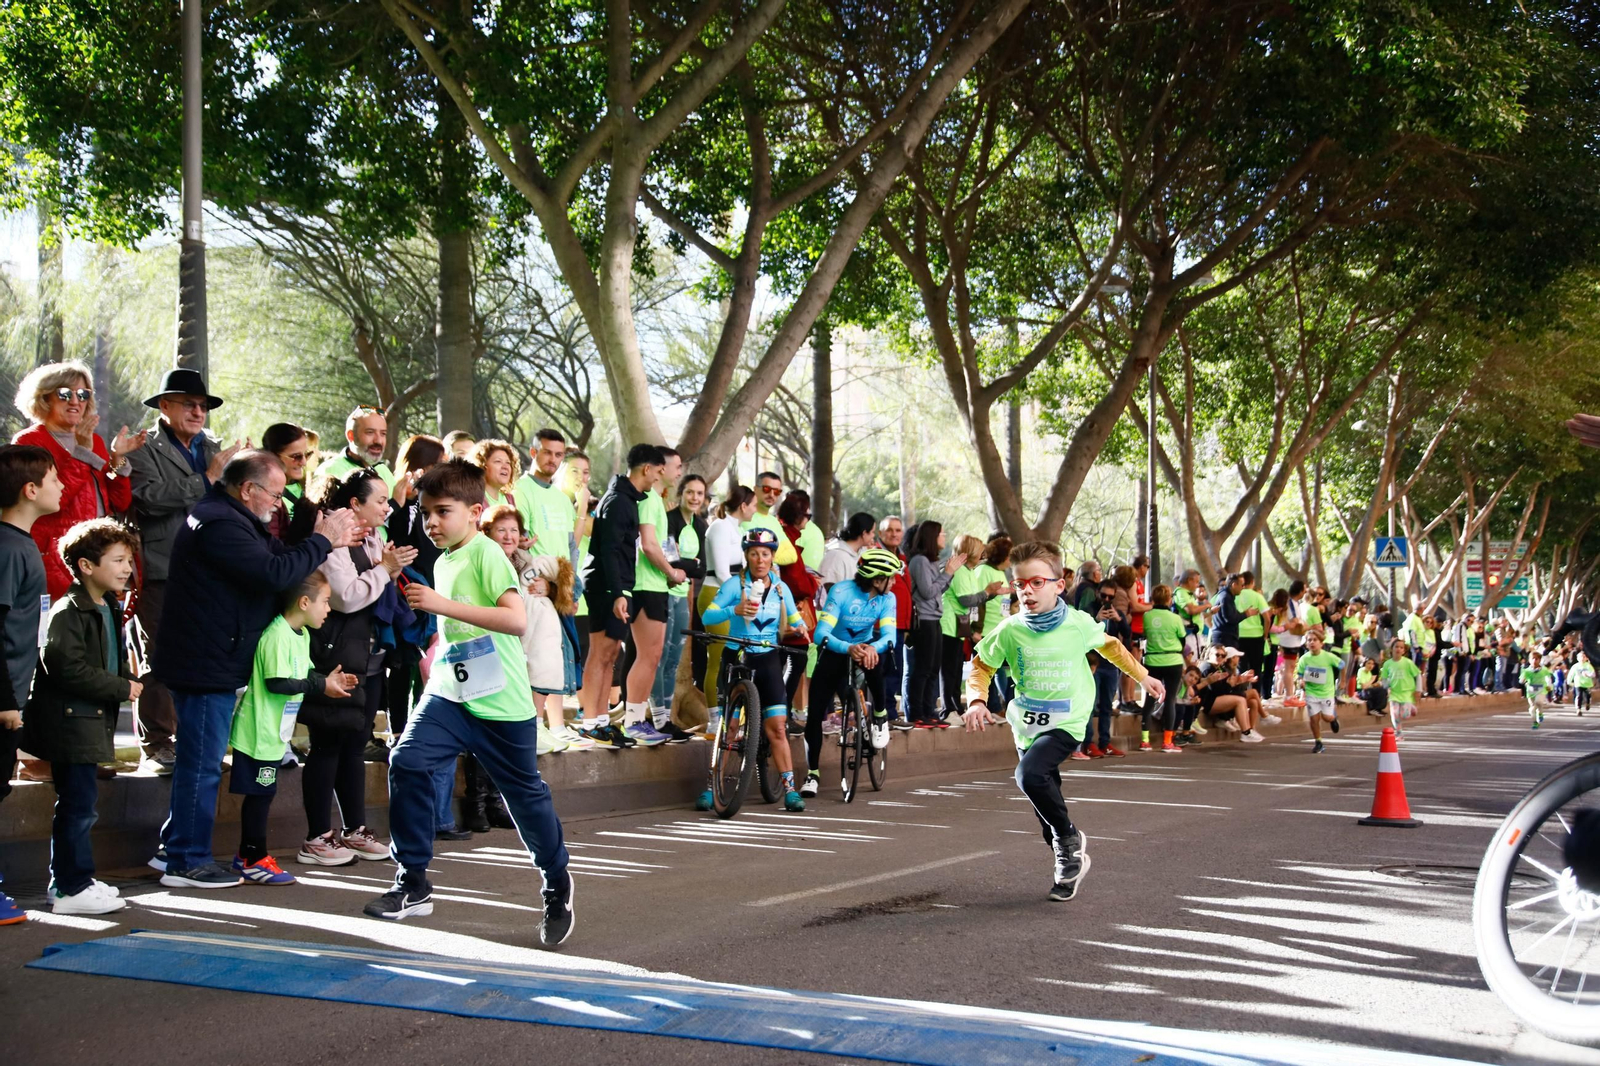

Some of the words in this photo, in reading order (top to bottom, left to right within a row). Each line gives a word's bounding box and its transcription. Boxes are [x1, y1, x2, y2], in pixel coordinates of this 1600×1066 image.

[1025, 659, 1036, 667] En
[1038, 659, 1073, 668] marcha
[454, 662, 469, 683] 6
[1025, 668, 1059, 678] contra
[1062, 668, 1071, 677] el
[1310, 671, 1320, 679] 48
[1026, 679, 1071, 691] cáncer
[1022, 710, 1050, 726] 58
